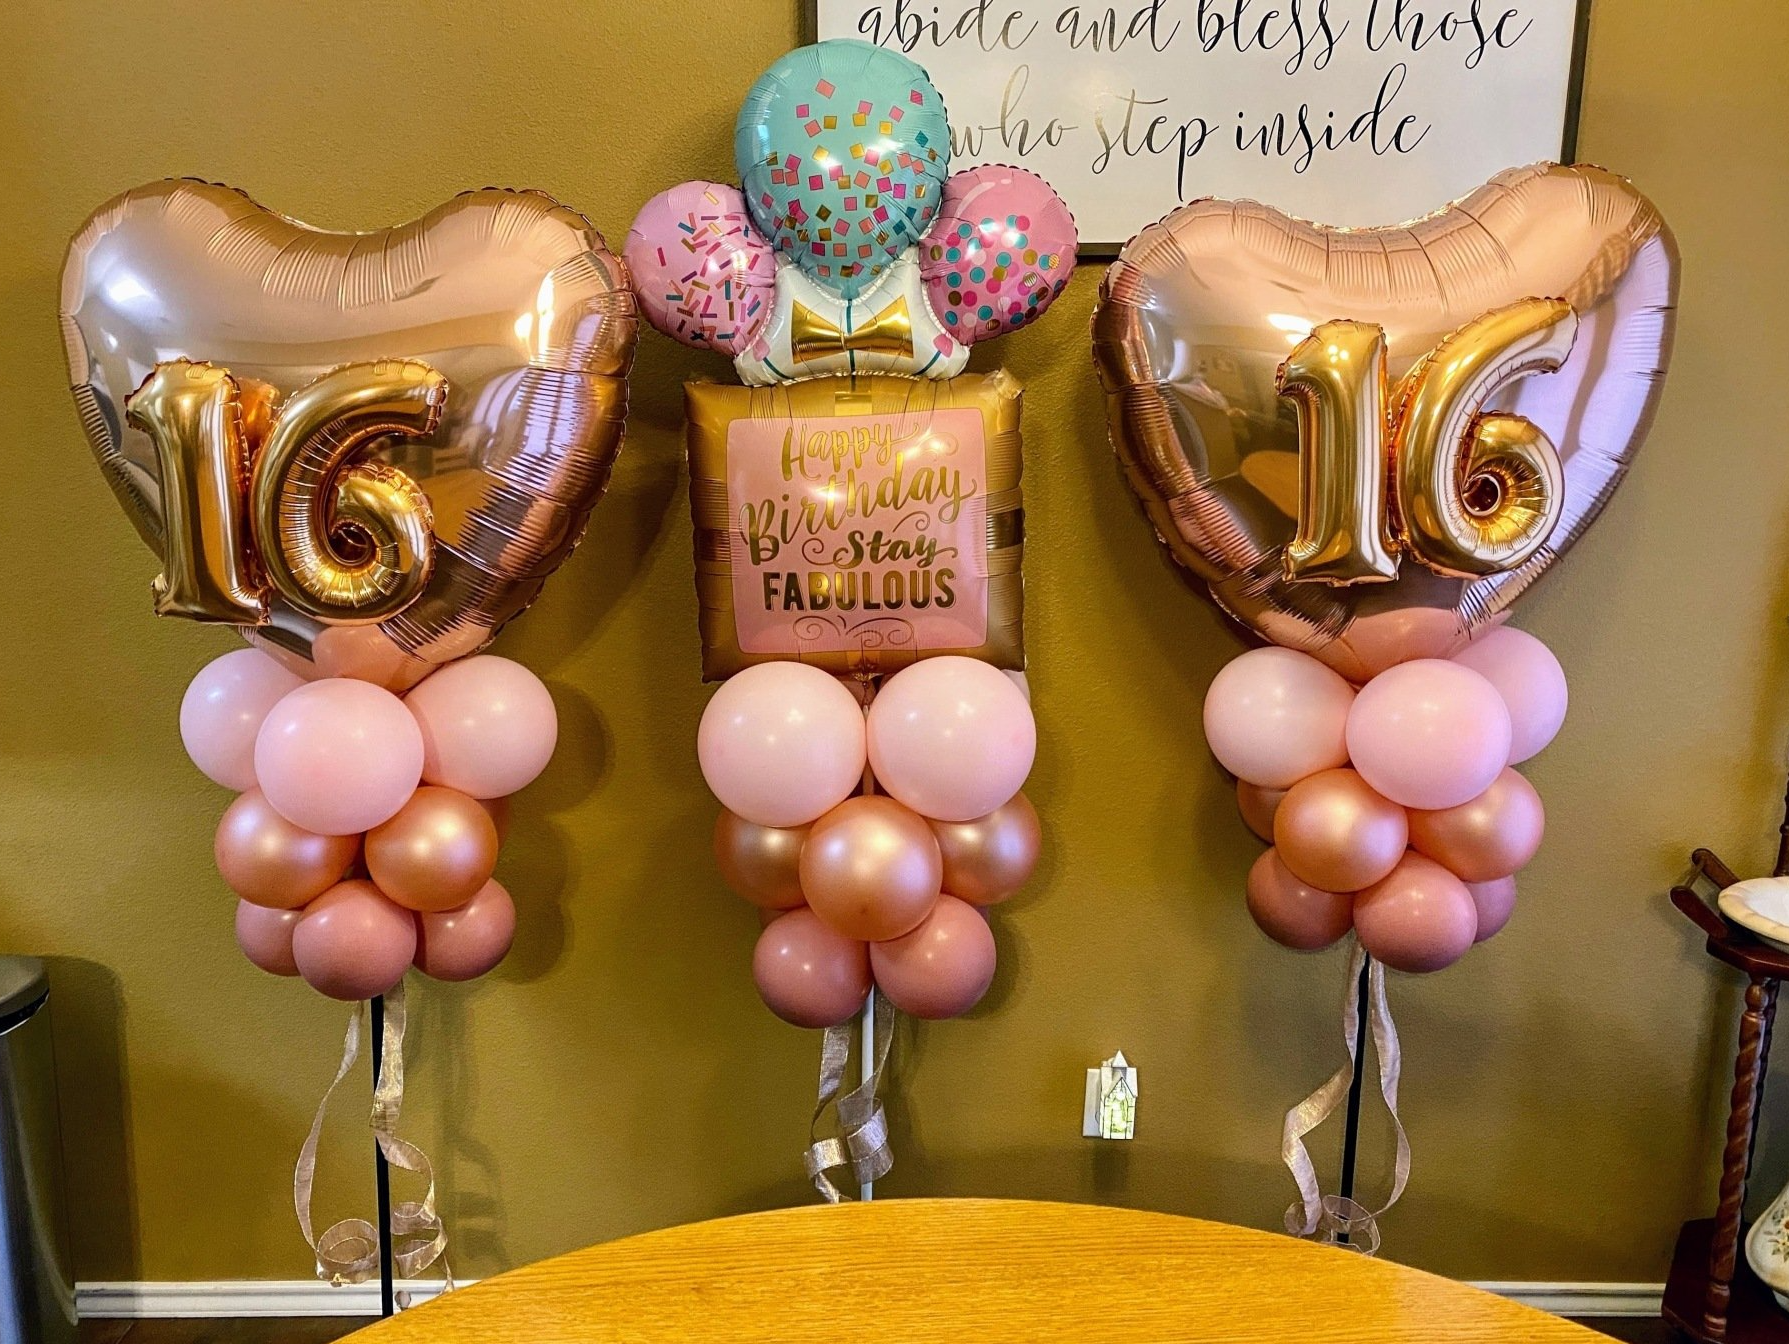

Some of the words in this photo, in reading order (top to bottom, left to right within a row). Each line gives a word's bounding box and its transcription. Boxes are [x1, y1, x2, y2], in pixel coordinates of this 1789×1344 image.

[857, 0, 1039, 53] abide
[1056, 0, 1181, 53] and
[1197, 0, 1350, 76] bless
[1366, 0, 1534, 70] those
[950, 64, 1079, 158] who
[1091, 88, 1220, 201] step
[1235, 62, 1432, 174] inside
[124, 356, 450, 627] 16
[781, 422, 920, 481] Happy
[1274, 296, 1580, 588] 16
[738, 438, 978, 566] Birthday
[812, 517, 958, 570] Stay
[762, 567, 956, 612] FABULOUS
